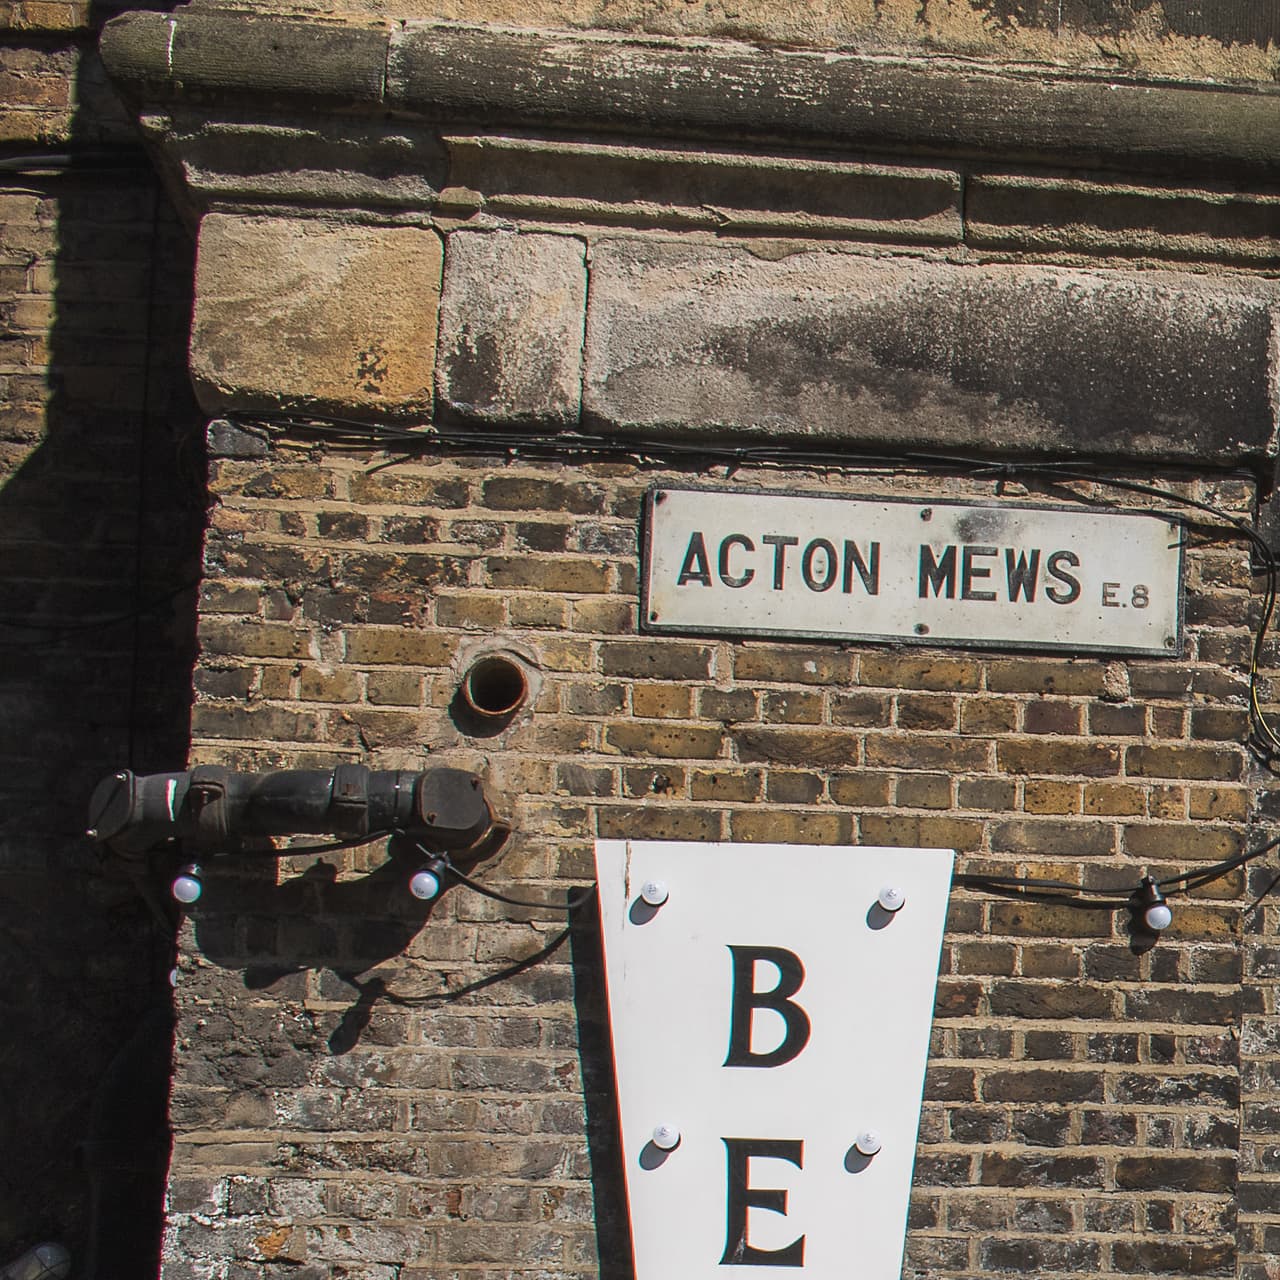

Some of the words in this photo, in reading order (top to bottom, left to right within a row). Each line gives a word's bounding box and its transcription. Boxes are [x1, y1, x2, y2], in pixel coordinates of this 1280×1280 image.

[677, 531, 881, 596] ACTON
[918, 544, 1083, 605] MEWS
[1101, 582, 1151, 610] E.8
